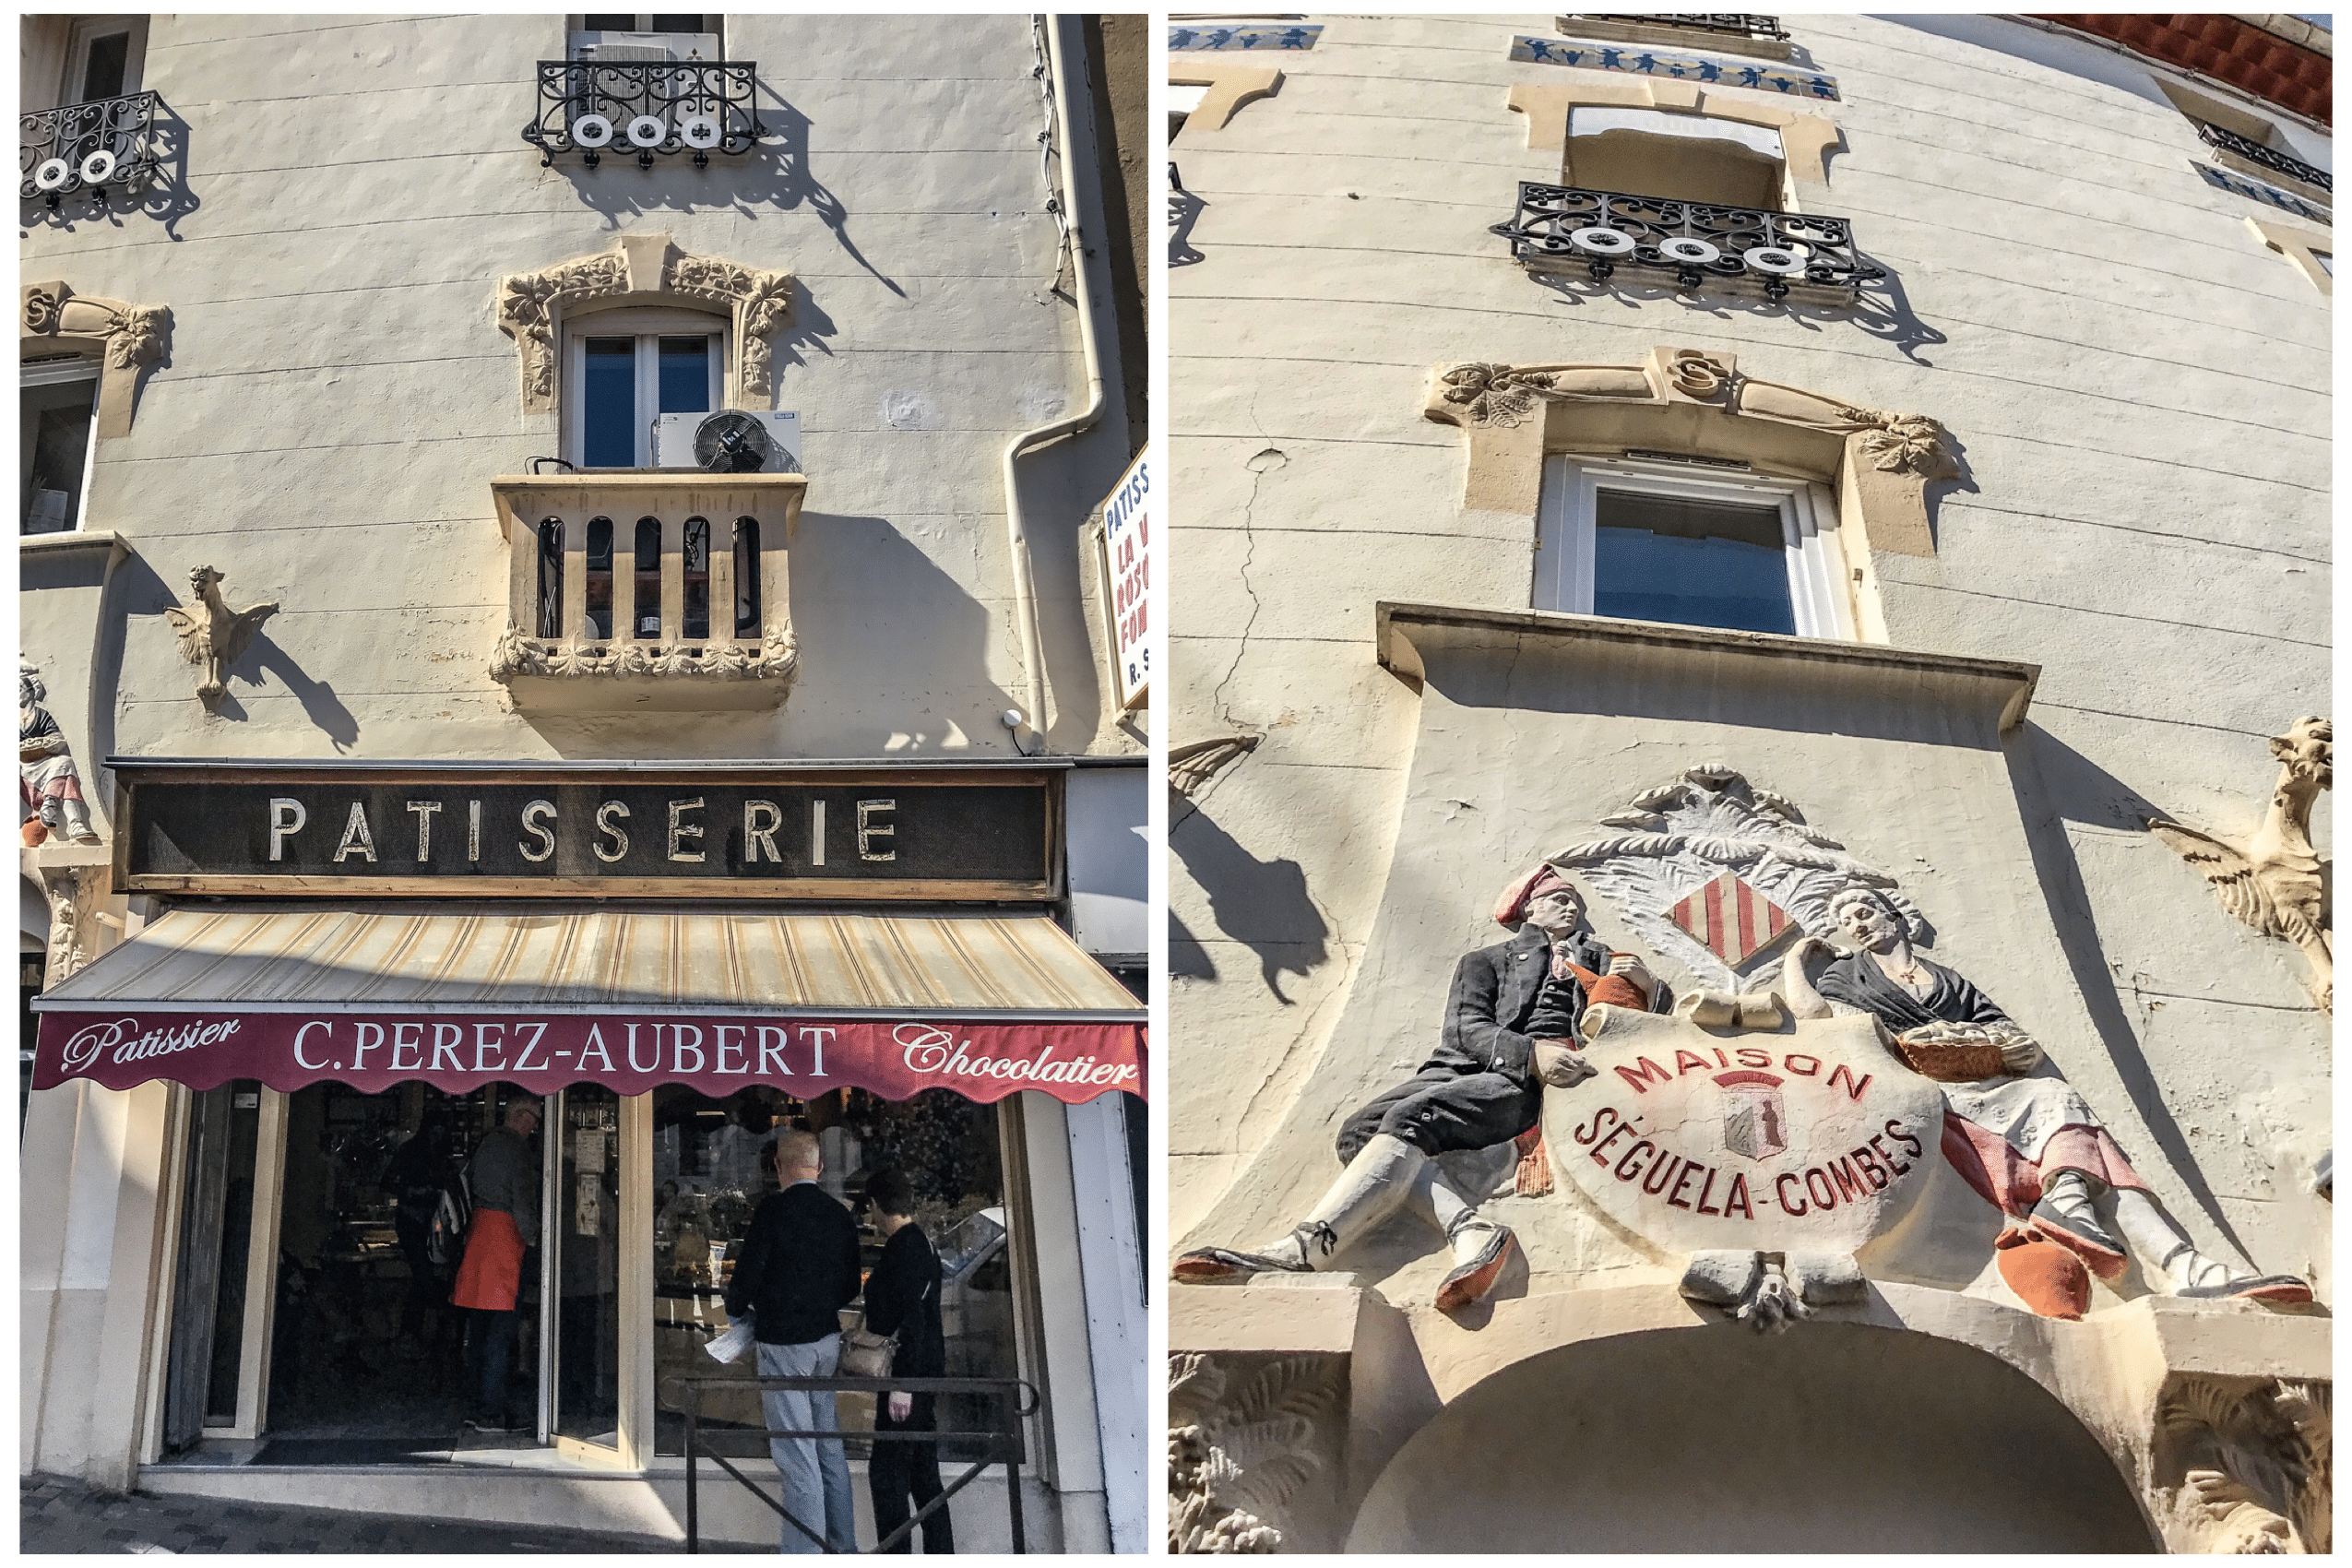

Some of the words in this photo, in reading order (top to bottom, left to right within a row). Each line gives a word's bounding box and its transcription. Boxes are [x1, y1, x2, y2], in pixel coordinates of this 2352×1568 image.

[1107, 463, 1148, 540] PATISS
[1118, 533, 1134, 574] LA
[1129, 663, 1140, 685] R.
[268, 796, 897, 866] PATISSERIE
[61, 1017, 241, 1075] Patissier
[892, 1022, 1139, 1085] Chocolatier
[1614, 1047, 1873, 1102] MAISON
[1574, 1106, 1924, 1221] SÉGUELA-COMBES
